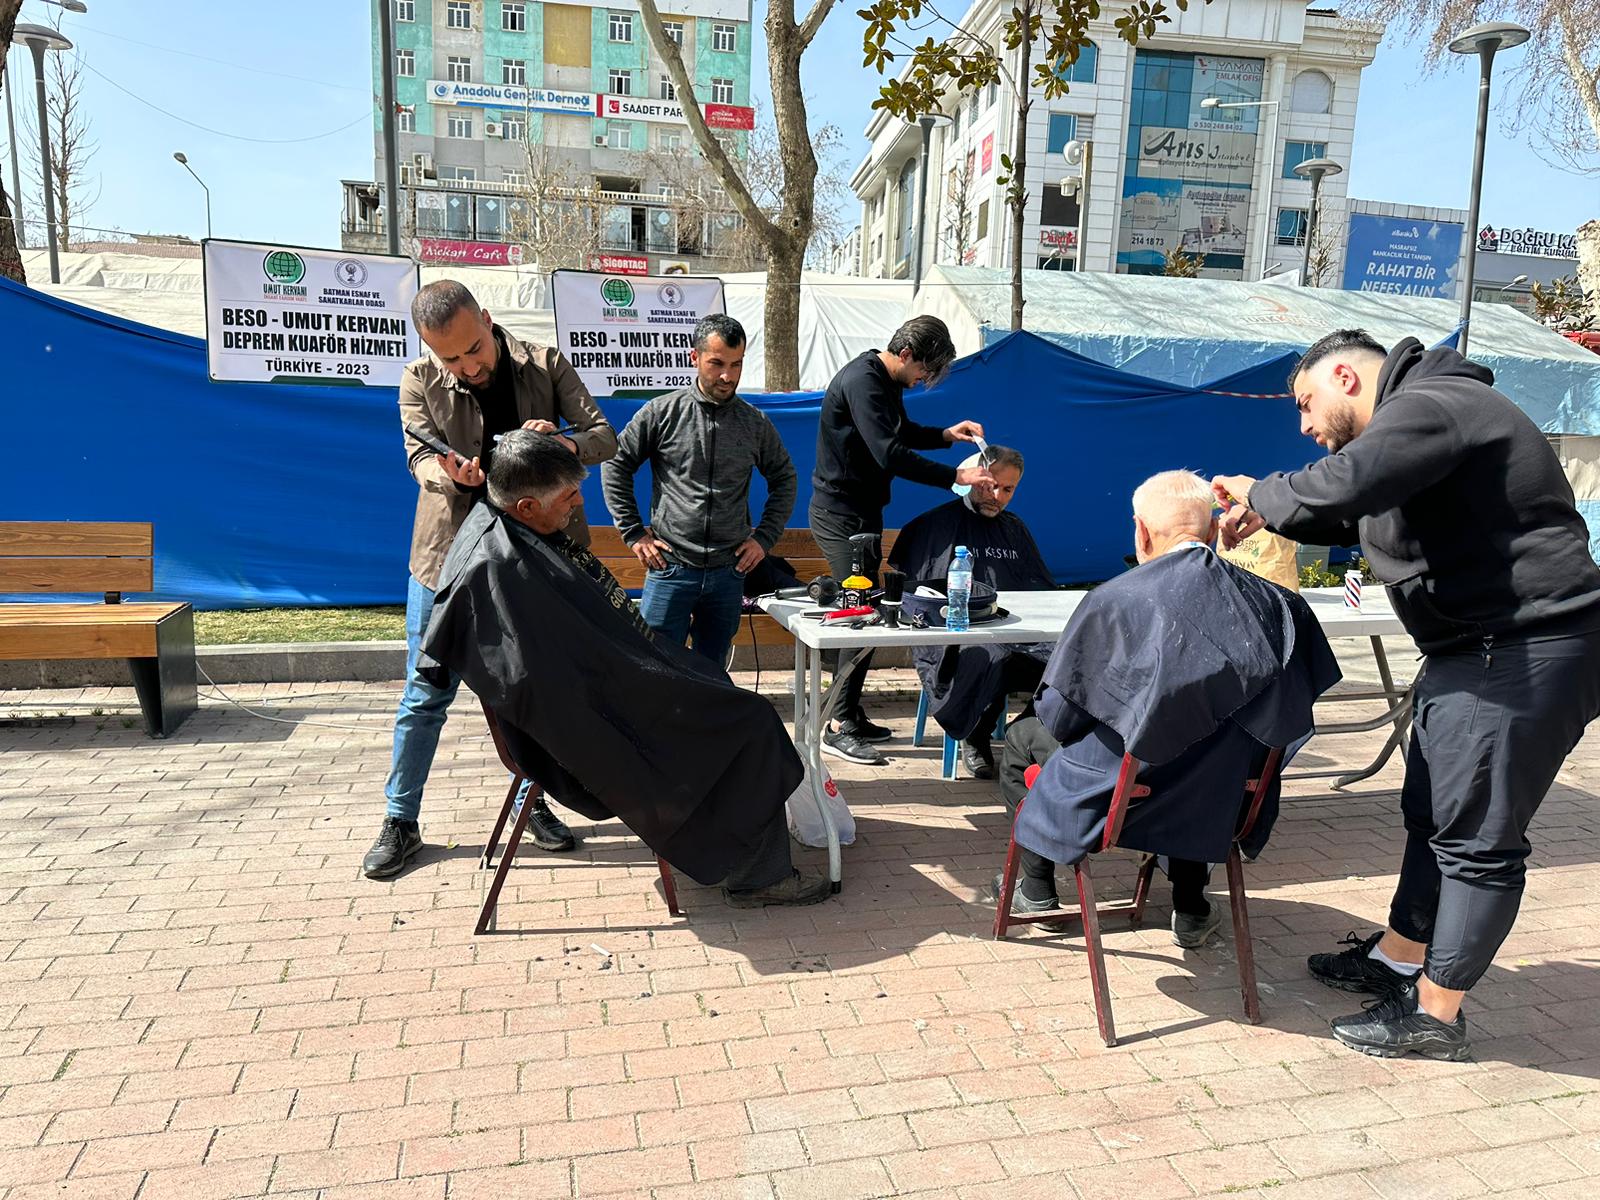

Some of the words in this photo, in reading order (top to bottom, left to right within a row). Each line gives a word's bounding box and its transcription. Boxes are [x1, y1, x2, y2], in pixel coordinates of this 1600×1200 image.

[1218, 62, 1263, 73] YAMAN
[453, 85, 501, 98] Anadolu
[623, 103, 661, 116] SAADET
[1500, 228, 1556, 247] DOĞRU
[1558, 234, 1578, 250] KA
[1544, 248, 1580, 258] KURUML
[1366, 262, 1414, 278] RAHAT
[1414, 264, 1436, 280] BİR
[264, 284, 281, 294] UMUT
[283, 285, 307, 296] KERVANI
[323, 288, 350, 296] BATMAN
[1361, 280, 1402, 295] NEFES
[1402, 284, 1435, 298] ALIN
[319, 296, 364, 306] SANATKARLAR
[365, 299, 385, 307] ODASI
[223, 308, 267, 327] BESO
[283, 312, 332, 331] UMUT
[337, 314, 406, 336] KERVANI
[224, 331, 284, 351] DEPREM
[288, 333, 346, 355] KUAFÖR
[351, 335, 407, 357] HİZMETİ
[570, 332, 607, 347] BESO
[620, 332, 659, 348] UMUT
[664, 332, 694, 348] KERV
[572, 352, 622, 368] DEPREM
[625, 350, 672, 368] KUAFÖR
[266, 358, 322, 373] TÜRKİYE
[337, 363, 370, 376] 2023
[607, 374, 653, 387] TÜRKİYE
[665, 376, 692, 386] 2023
